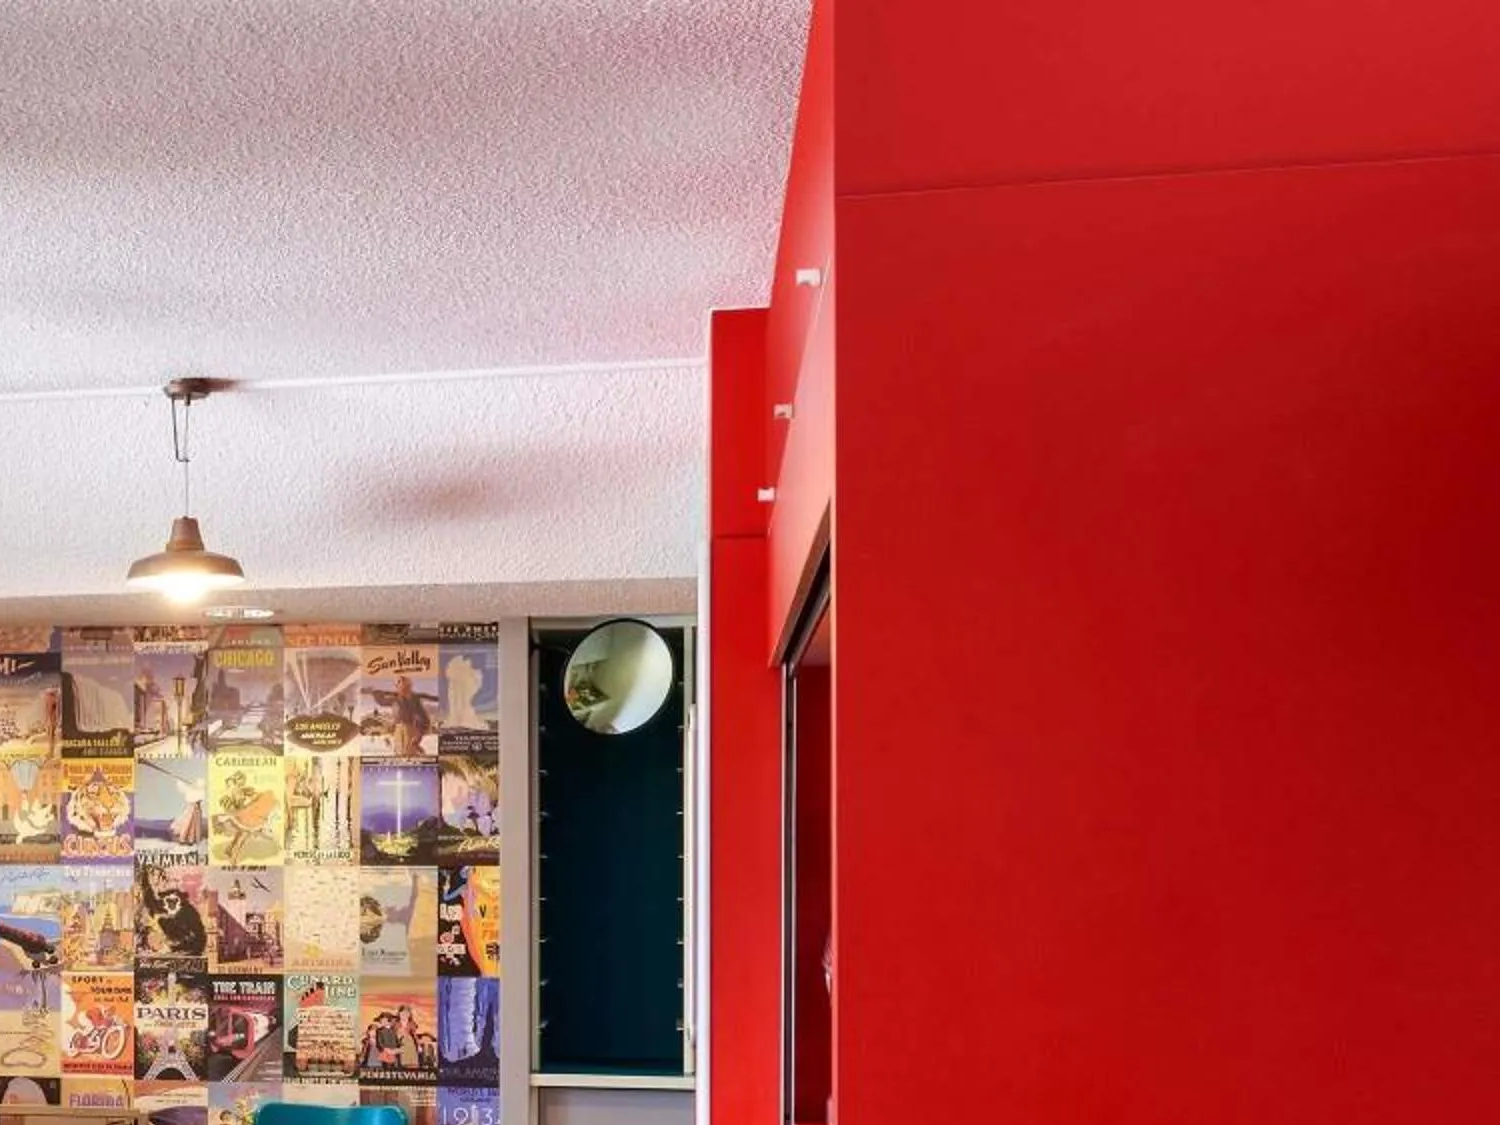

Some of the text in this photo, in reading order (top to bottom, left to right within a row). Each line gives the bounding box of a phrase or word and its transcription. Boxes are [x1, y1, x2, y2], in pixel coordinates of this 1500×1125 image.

[215, 757, 277, 768] CARIBBEAN
[71, 976, 103, 984] SPORT
[212, 981, 276, 994] THE TRAIN
[136, 1007, 206, 1020] PARIS
[68, 1093, 125, 1107] FLORIDA
